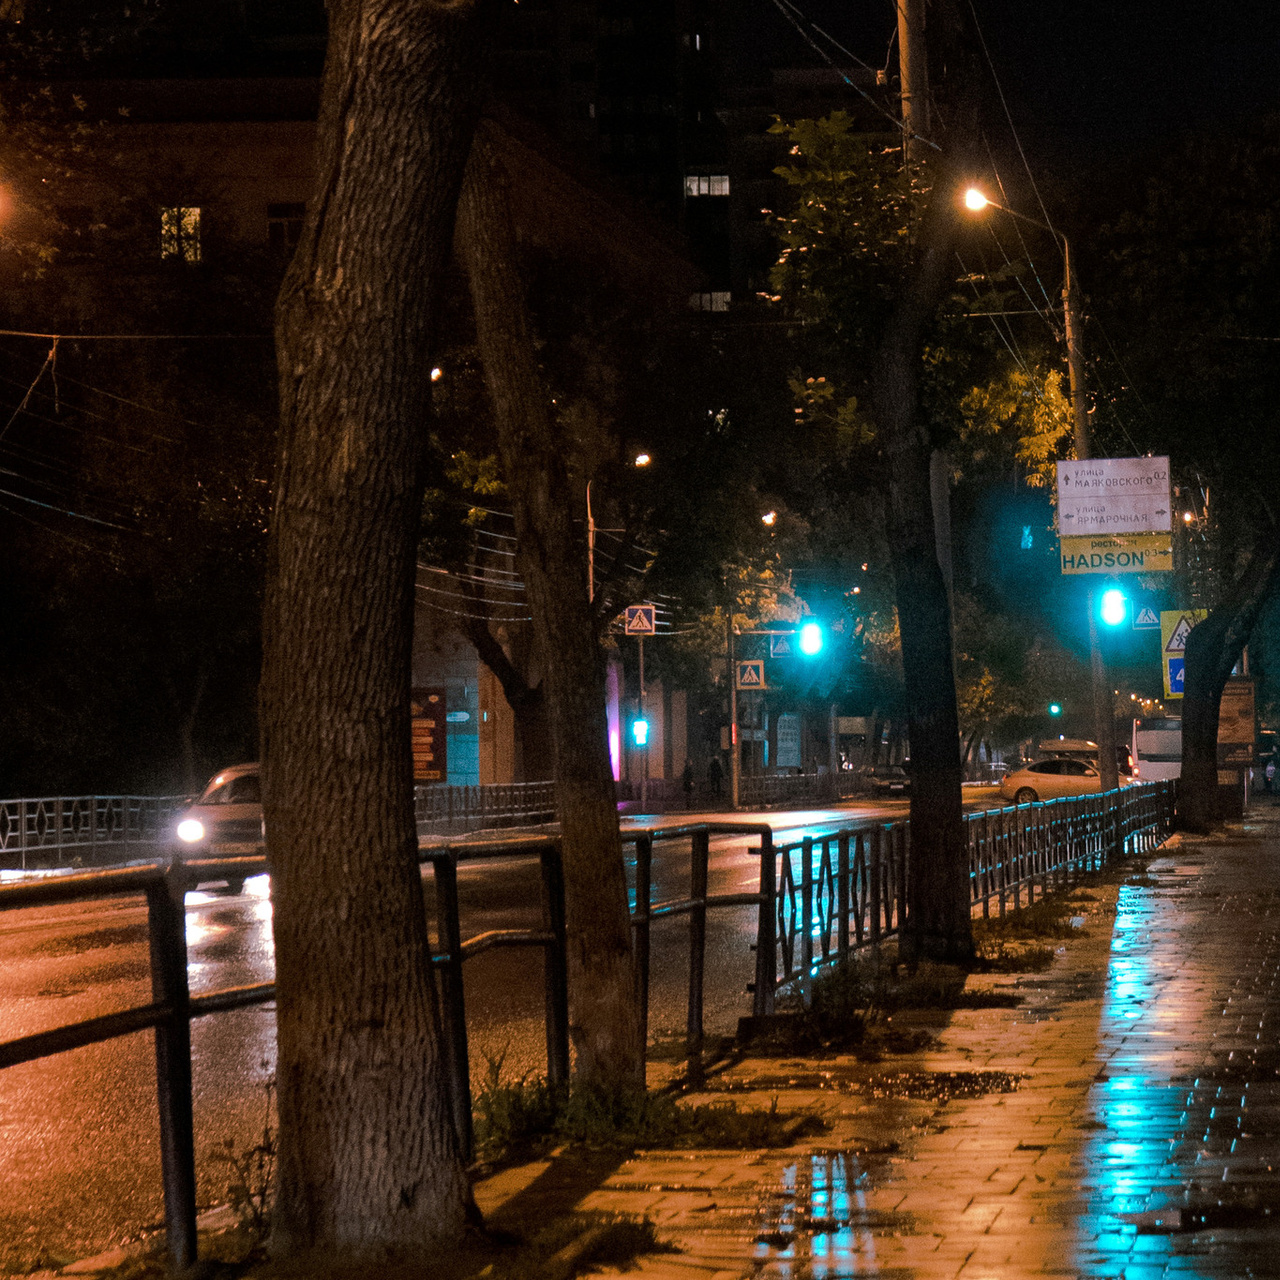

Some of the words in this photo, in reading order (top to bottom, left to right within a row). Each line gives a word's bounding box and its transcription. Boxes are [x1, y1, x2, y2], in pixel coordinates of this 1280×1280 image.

[1074, 469, 1104, 478] улица
[1074, 476, 1153, 488] МАЯКОВСКОГО
[1075, 506, 1105, 514] улица
[1077, 514, 1148, 524] ЯРМАРОЧНАЯ
[1090, 540, 1137, 549] рестон
[1062, 551, 1144, 569] HADSON
